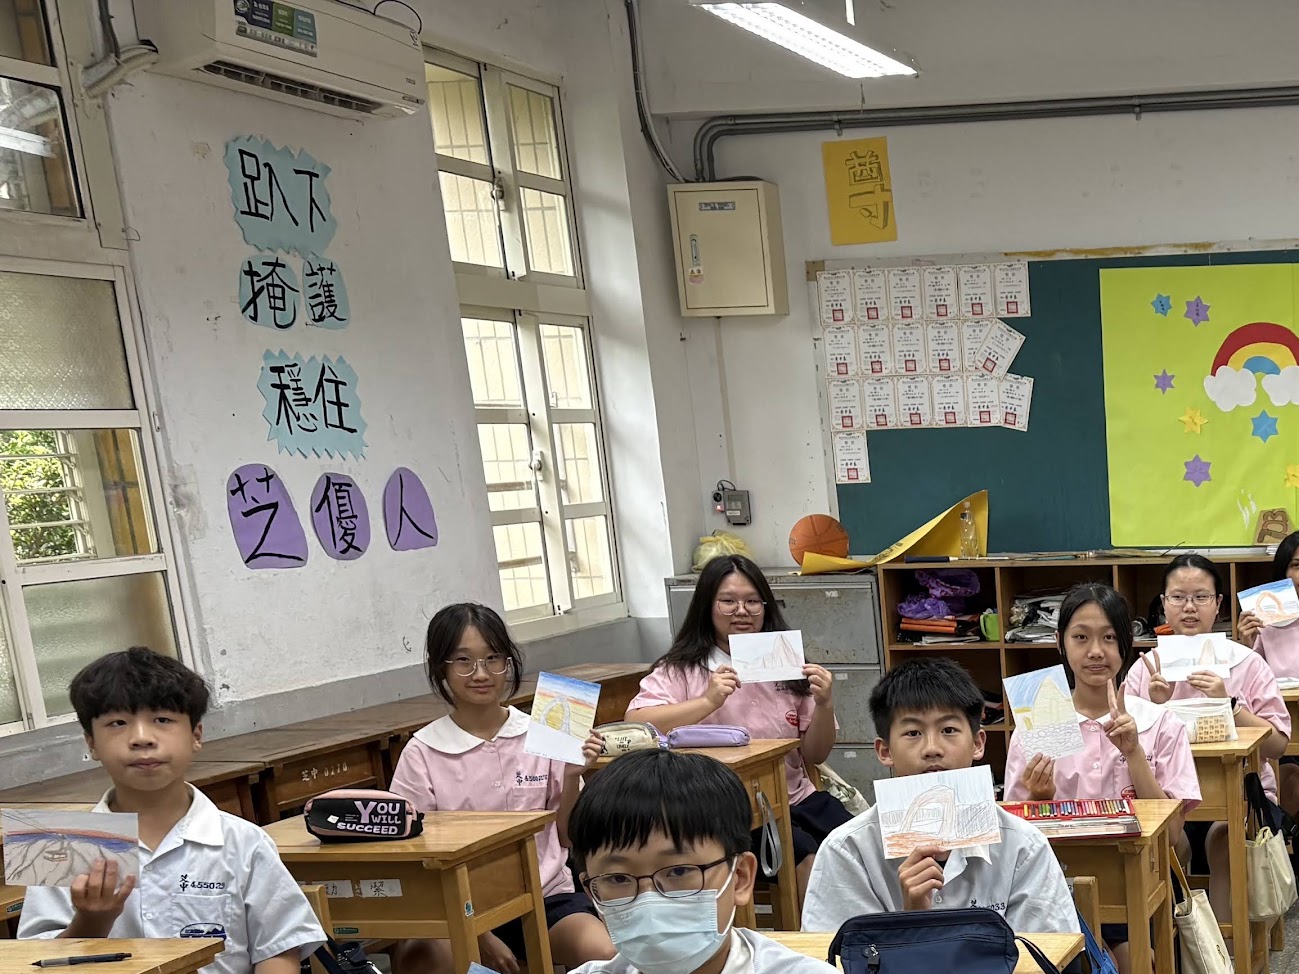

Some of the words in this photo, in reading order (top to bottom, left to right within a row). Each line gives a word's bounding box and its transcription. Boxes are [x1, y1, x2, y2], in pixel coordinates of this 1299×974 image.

[239, 148, 328, 232] 趴下
[241, 257, 347, 329] 掩護
[269, 362, 358, 435] 穩住
[230, 467, 434, 563] 芝優人
[336, 822, 398, 835] SUCCEED
[354, 800, 400, 824] YOU
[371, 815, 402, 824] WILL
